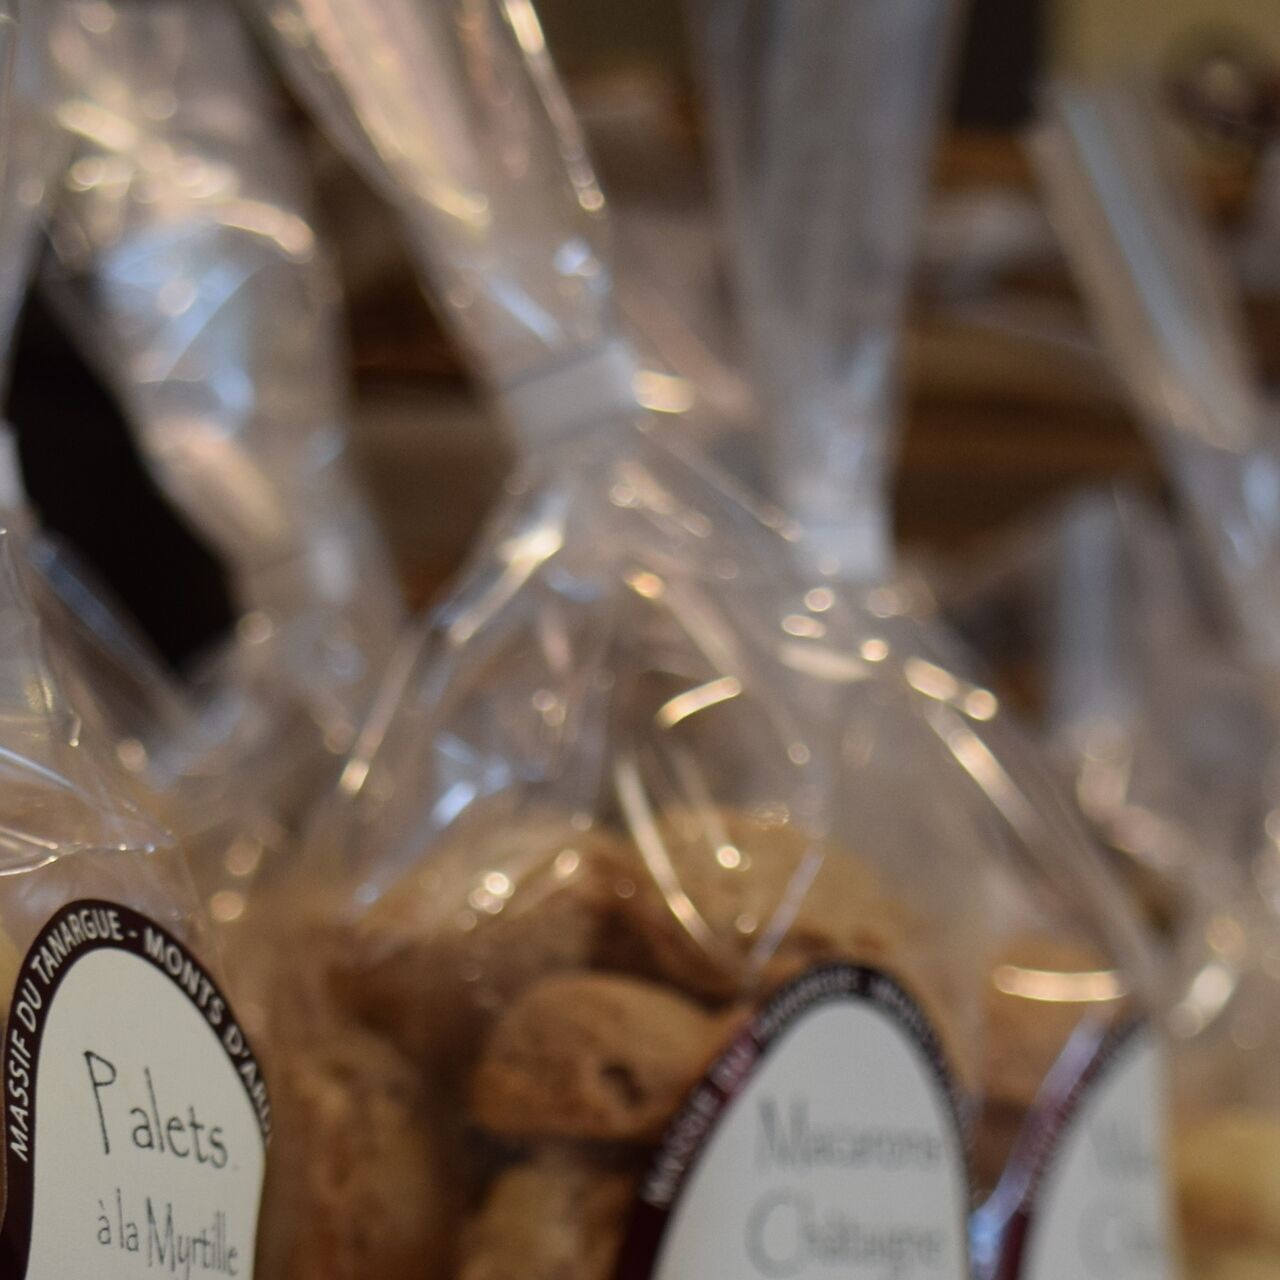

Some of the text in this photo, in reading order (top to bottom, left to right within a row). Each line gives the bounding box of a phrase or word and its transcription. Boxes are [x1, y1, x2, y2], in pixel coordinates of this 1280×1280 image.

[30, 908, 124, 985] TANARGUE
[143, 926, 226, 1025] MONTS
[15, 978, 43, 1033] DU
[8, 1029, 33, 1163] MASSIF
[83, 1050, 229, 1169] Palets
[97, 1199, 112, 1246] à
[116, 1187, 140, 1252] la
